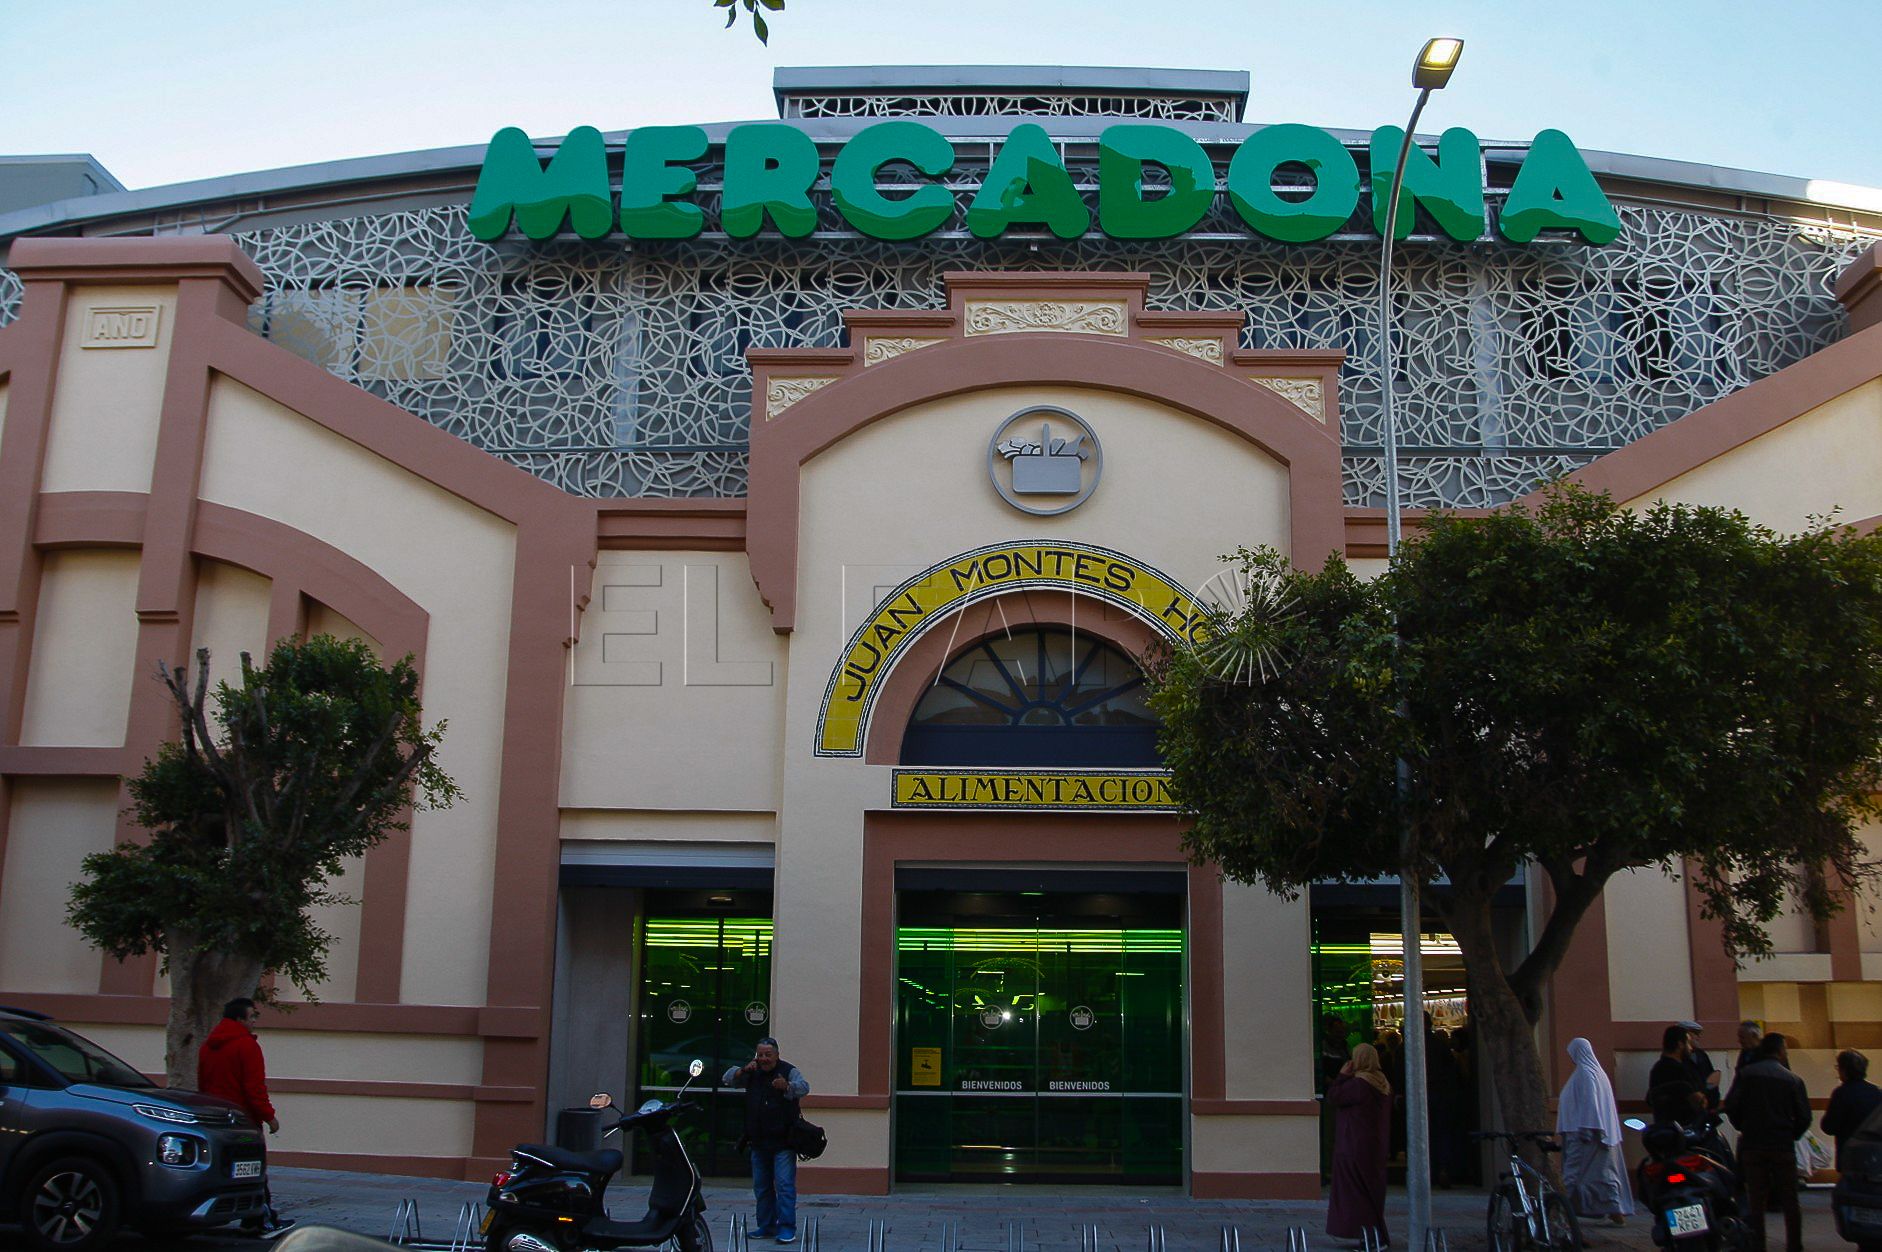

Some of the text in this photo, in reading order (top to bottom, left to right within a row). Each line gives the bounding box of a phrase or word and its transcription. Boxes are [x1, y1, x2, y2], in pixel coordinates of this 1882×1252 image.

[467, 123, 1622, 246] MERCADONA
[847, 593, 925, 702] JUAN
[949, 550, 1137, 592] MONTES
[961, 1080, 1023, 1091] BIENVENIDOS
[1049, 1080, 1111, 1091] BIENVENIDOS
